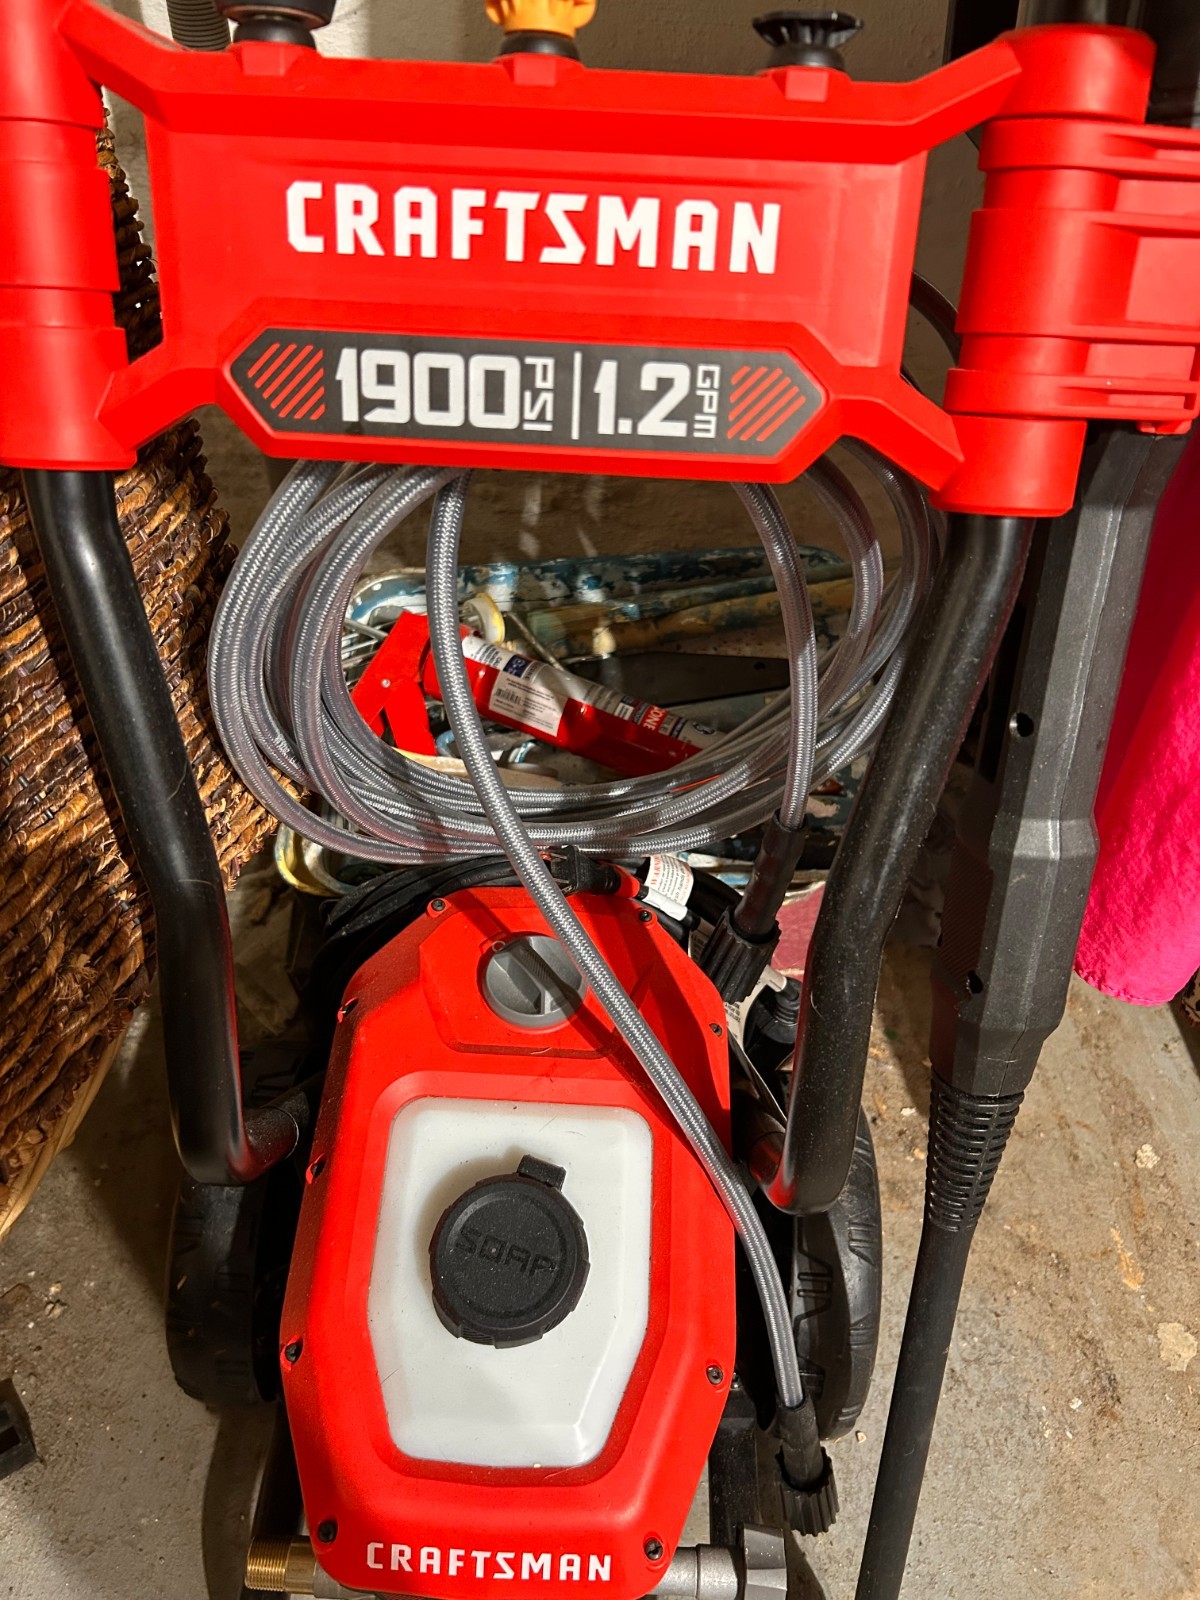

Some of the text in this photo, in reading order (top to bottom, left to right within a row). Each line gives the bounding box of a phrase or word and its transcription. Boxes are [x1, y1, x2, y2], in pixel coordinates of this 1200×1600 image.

[285, 180, 781, 275] CRAFTSMAN
[335, 347, 721, 439] 1900 PSI 1.2 GPM
[455, 1227, 557, 1277] SOAP
[366, 1542, 611, 1581] CRAFTSMAN
